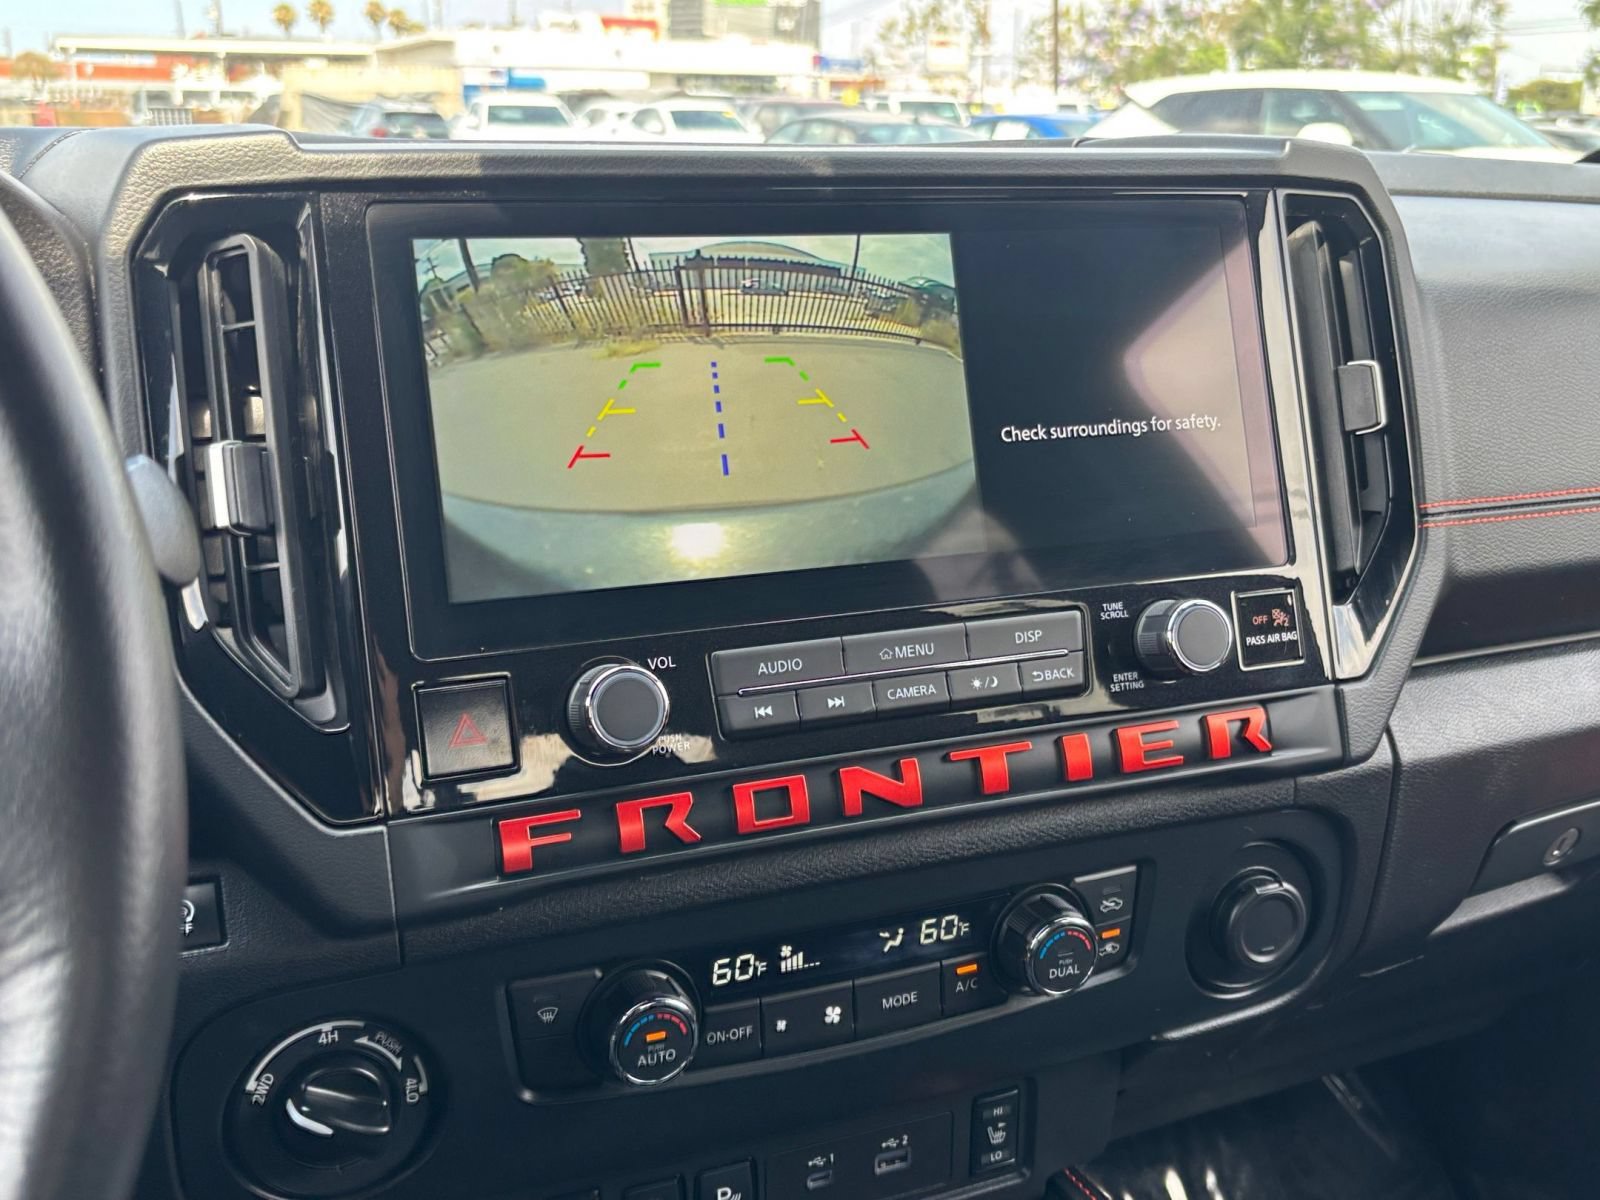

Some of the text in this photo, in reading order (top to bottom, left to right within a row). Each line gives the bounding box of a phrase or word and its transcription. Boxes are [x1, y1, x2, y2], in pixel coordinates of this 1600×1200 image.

[1001, 413, 1221, 442] Check surroundings for safety.
[1102, 602, 1124, 611] TUNE
[1100, 611, 1129, 620] SCROLL
[1252, 615, 1268, 625] OFF
[1014, 629, 1043, 644] DISP
[1246, 631, 1298, 646] PASS AIR BAG
[895, 643, 935, 659] MENU
[647, 656, 677, 670] VOL
[757, 658, 803, 676] AUDIO
[1044, 667, 1075, 681] BACK
[1113, 672, 1139, 682] ENTER
[887, 684, 937, 701] CAMERA
[1110, 681, 1145, 692] SETTING
[652, 742, 691, 754] POWER
[498, 705, 1275, 874] FRONTIER
[1049, 964, 1080, 979] DUAL
[955, 979, 978, 993] A/C
[882, 991, 918, 1009] MODE
[318, 1030, 339, 1046] 4H
[637, 1049, 676, 1068] AUTO
[252, 1073, 274, 1106] 2WD
[993, 1106, 1003, 1117] HI
[990, 1150, 1002, 1162] LO
